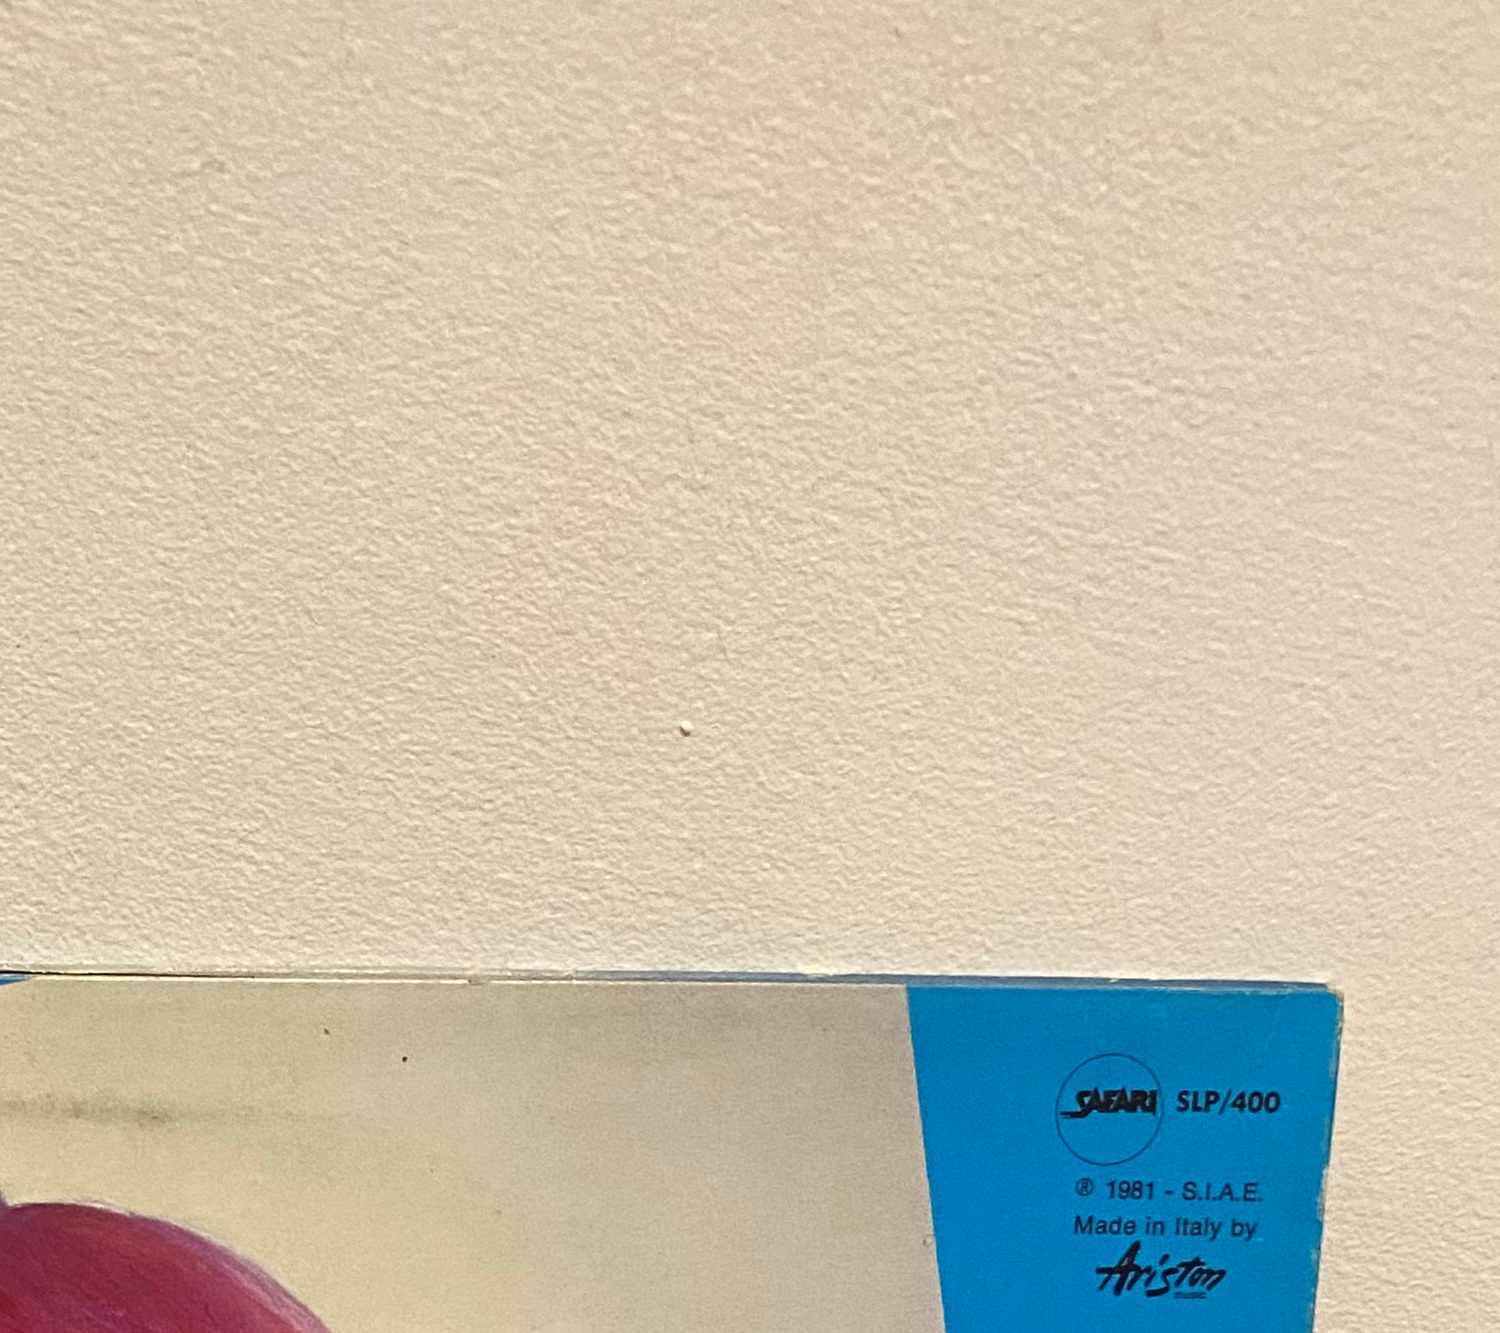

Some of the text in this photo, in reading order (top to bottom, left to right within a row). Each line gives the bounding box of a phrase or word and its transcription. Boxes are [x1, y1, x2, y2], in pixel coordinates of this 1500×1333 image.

[1059, 1086, 1158, 1119] SAFARI
[1175, 1089, 1281, 1114] SLP/400
[1106, 1181, 1155, 1199] 1981
[1182, 1182, 1263, 1201] S.I.A.E.
[1073, 1215, 1257, 1241] Made in Italy by
[1095, 1240, 1226, 1297] Ariston
